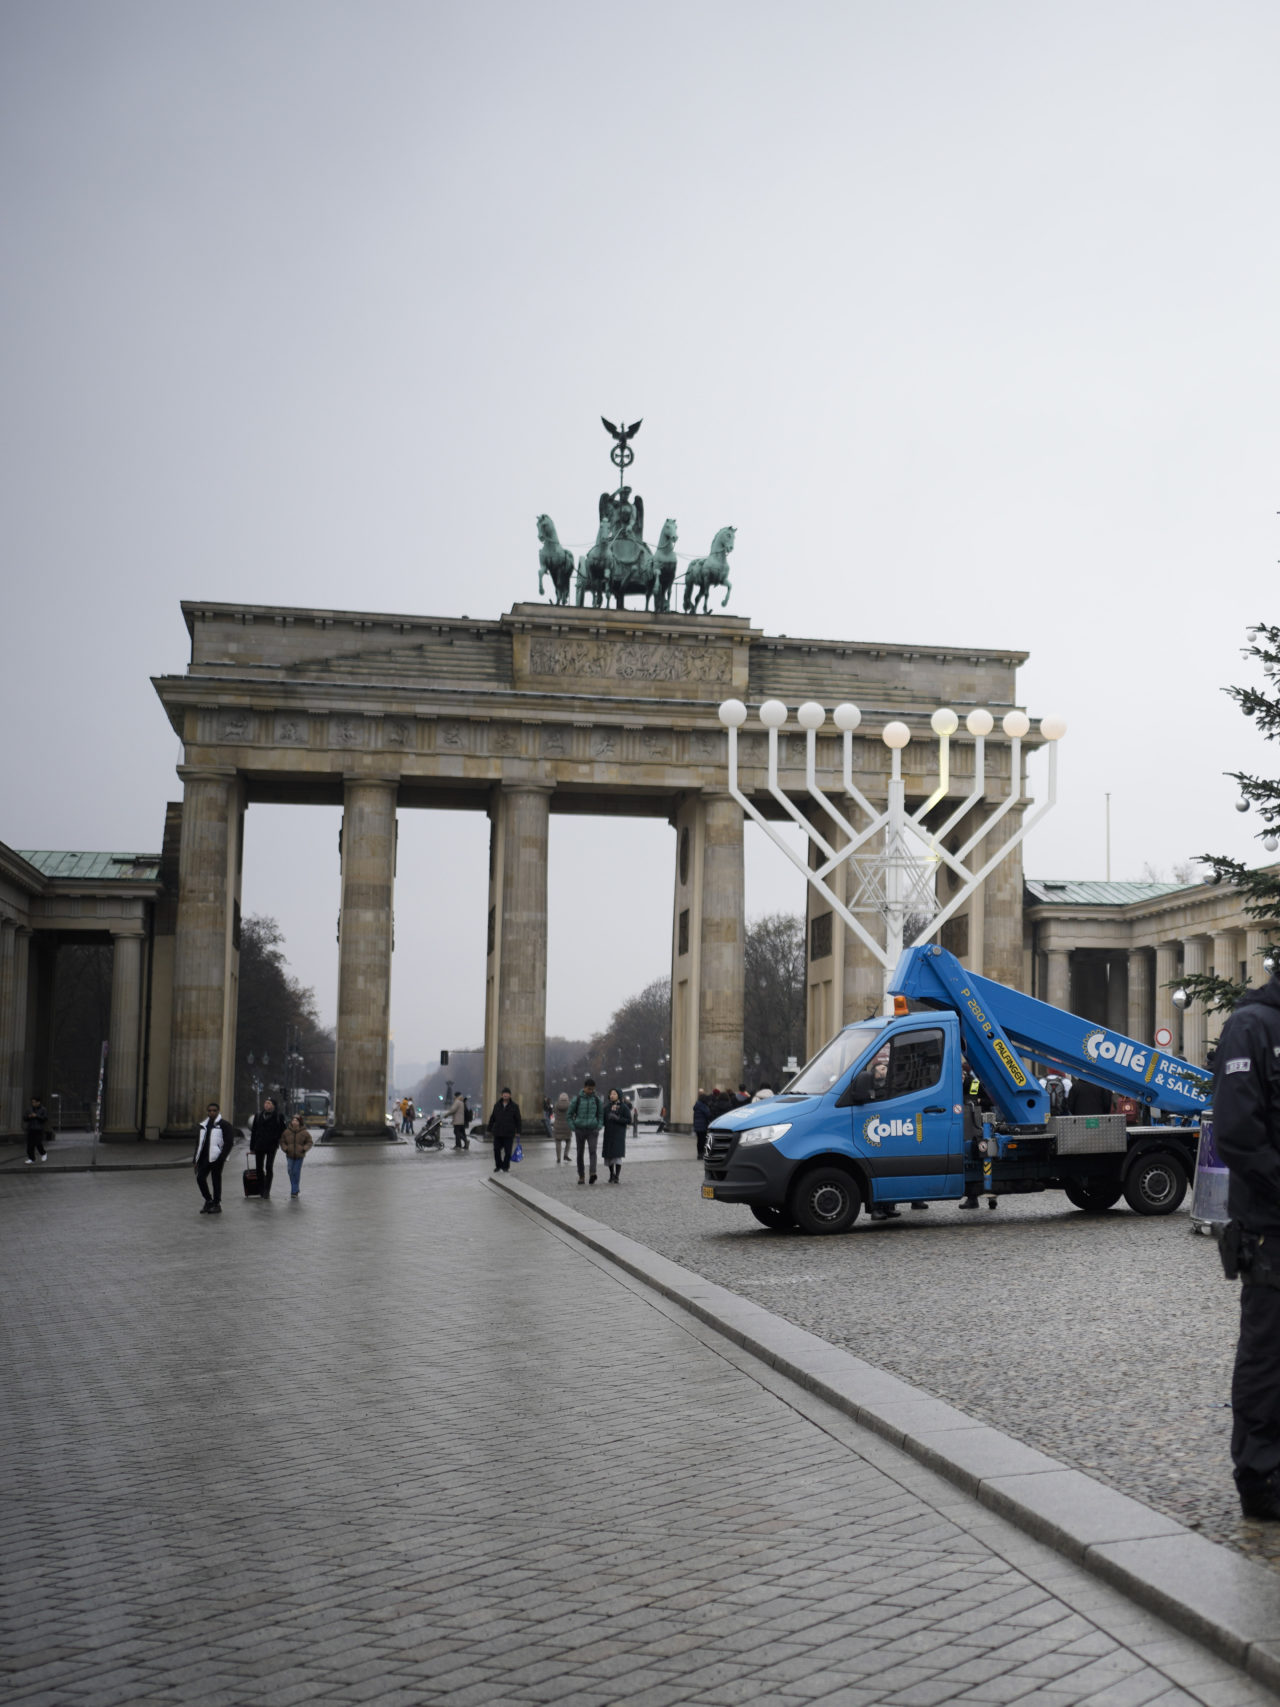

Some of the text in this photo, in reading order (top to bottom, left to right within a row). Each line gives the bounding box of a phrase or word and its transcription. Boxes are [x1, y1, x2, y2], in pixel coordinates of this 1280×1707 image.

[960, 987, 992, 1032] P 280 B
[994, 1041, 1025, 1085] PALFINGER
[1086, 1033, 1148, 1073] Collé
[1154, 1073, 1207, 1103] & SALES
[1160, 1059, 1209, 1087] RENT
[867, 1118, 914, 1142] Collé
